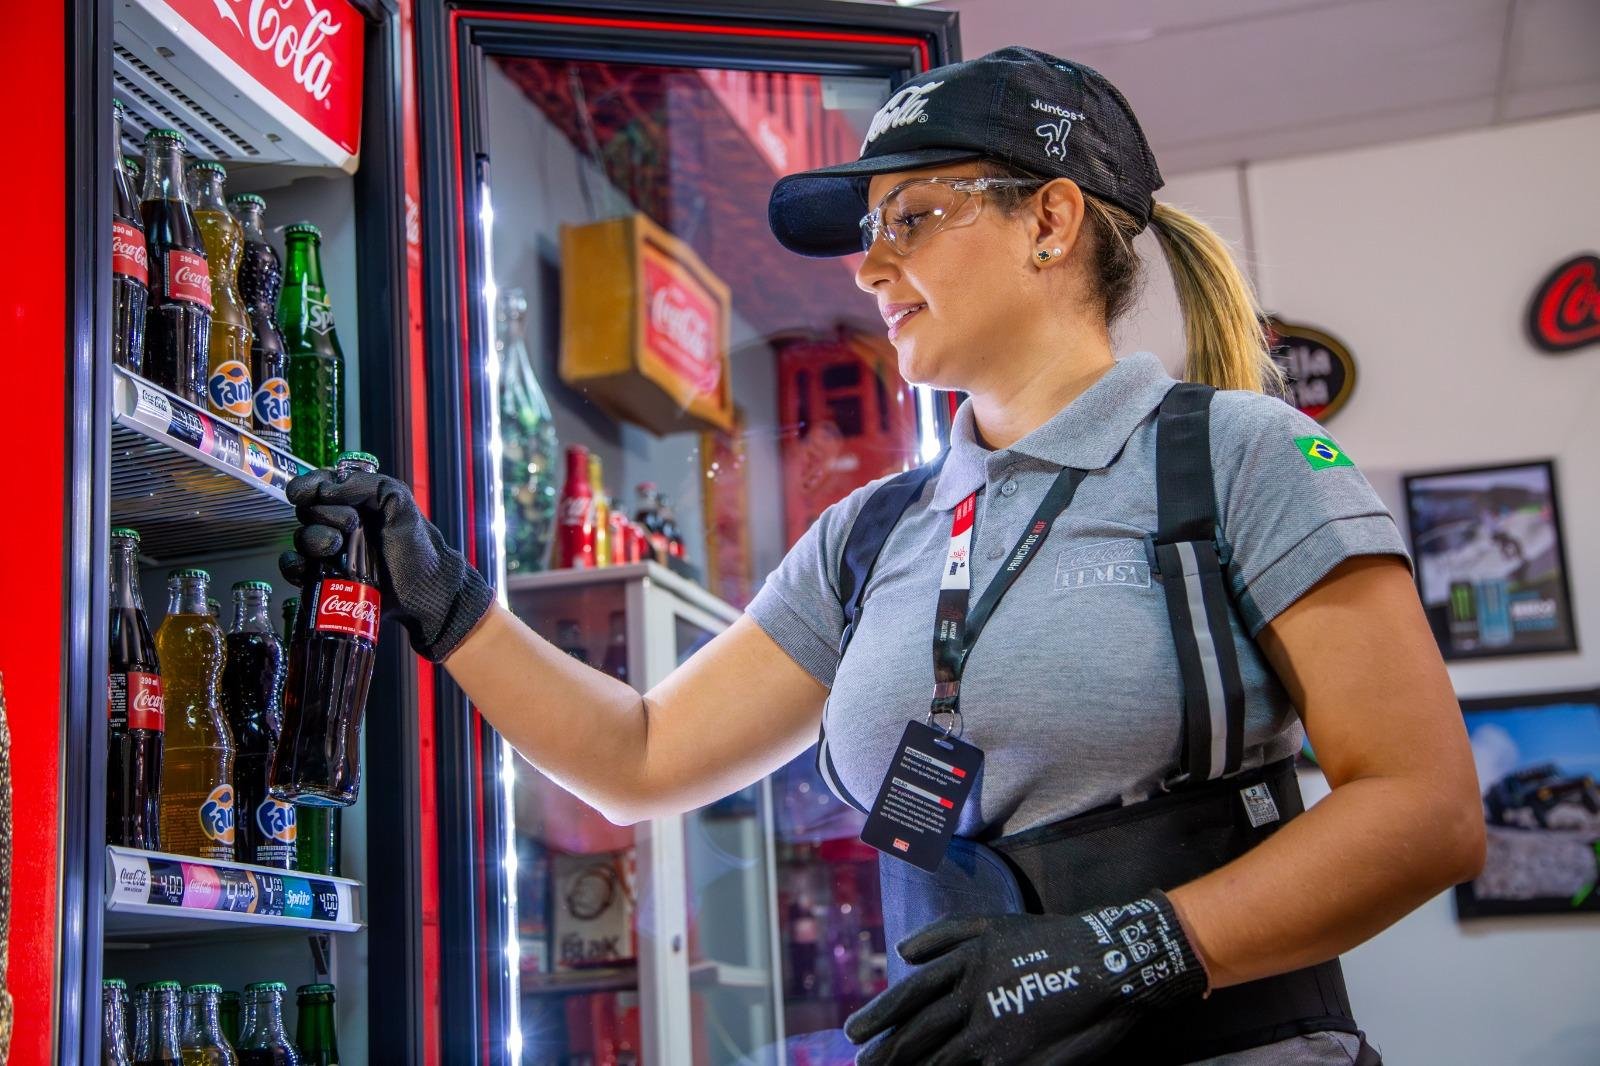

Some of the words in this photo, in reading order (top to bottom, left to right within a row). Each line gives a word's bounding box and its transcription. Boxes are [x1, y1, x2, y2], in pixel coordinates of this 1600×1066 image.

[1031, 99, 1086, 122] Juntos+
[1007, 534, 1040, 572] PRINCÍPIOS
[330, 583, 344, 592] 290
[287, 890, 311, 908] Sprite
